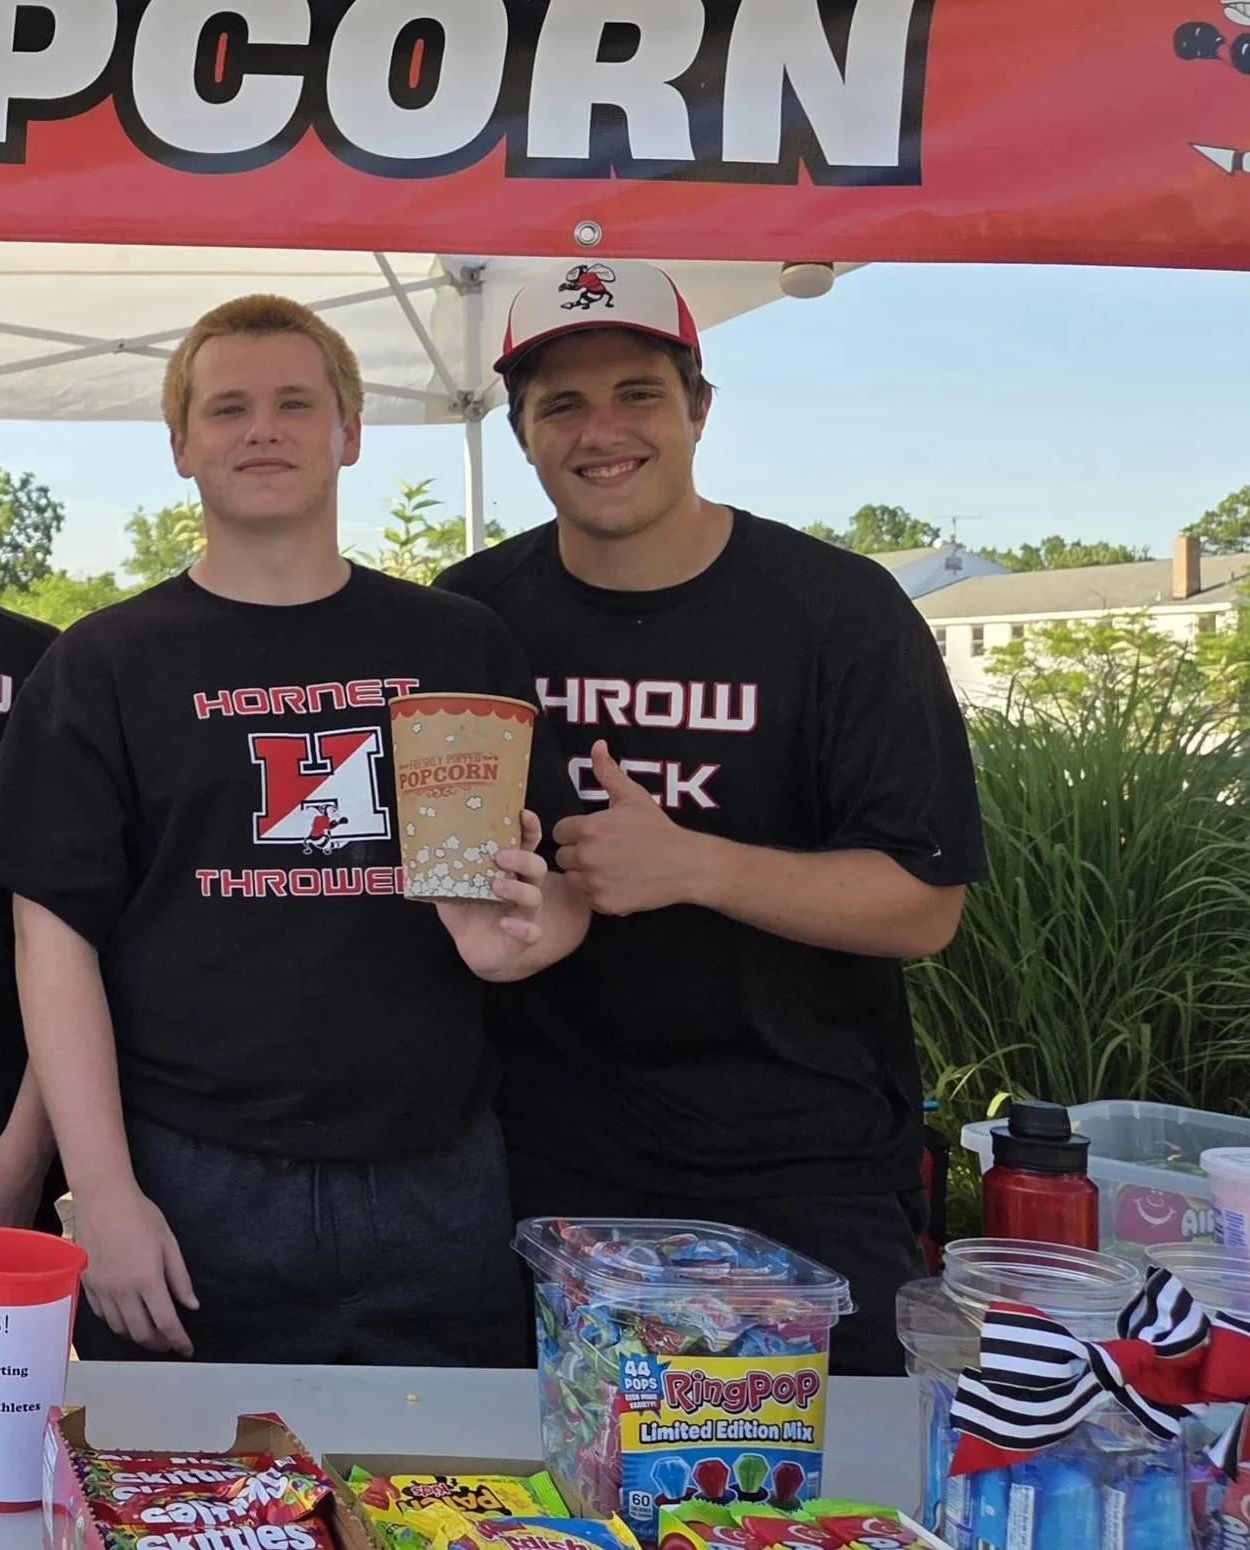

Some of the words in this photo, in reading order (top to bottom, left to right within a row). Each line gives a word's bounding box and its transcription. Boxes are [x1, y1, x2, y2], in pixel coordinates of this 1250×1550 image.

[193, 678, 420, 719] HORNET
[399, 763, 499, 789] POPCORN
[624, 1360, 651, 1377] 44
[624, 1377, 658, 1391] POPS
[640, 1420, 713, 1443] Limited
[716, 1419, 779, 1443] Edition
[782, 1420, 815, 1443] Mix
[632, 1493, 650, 1507] 60
